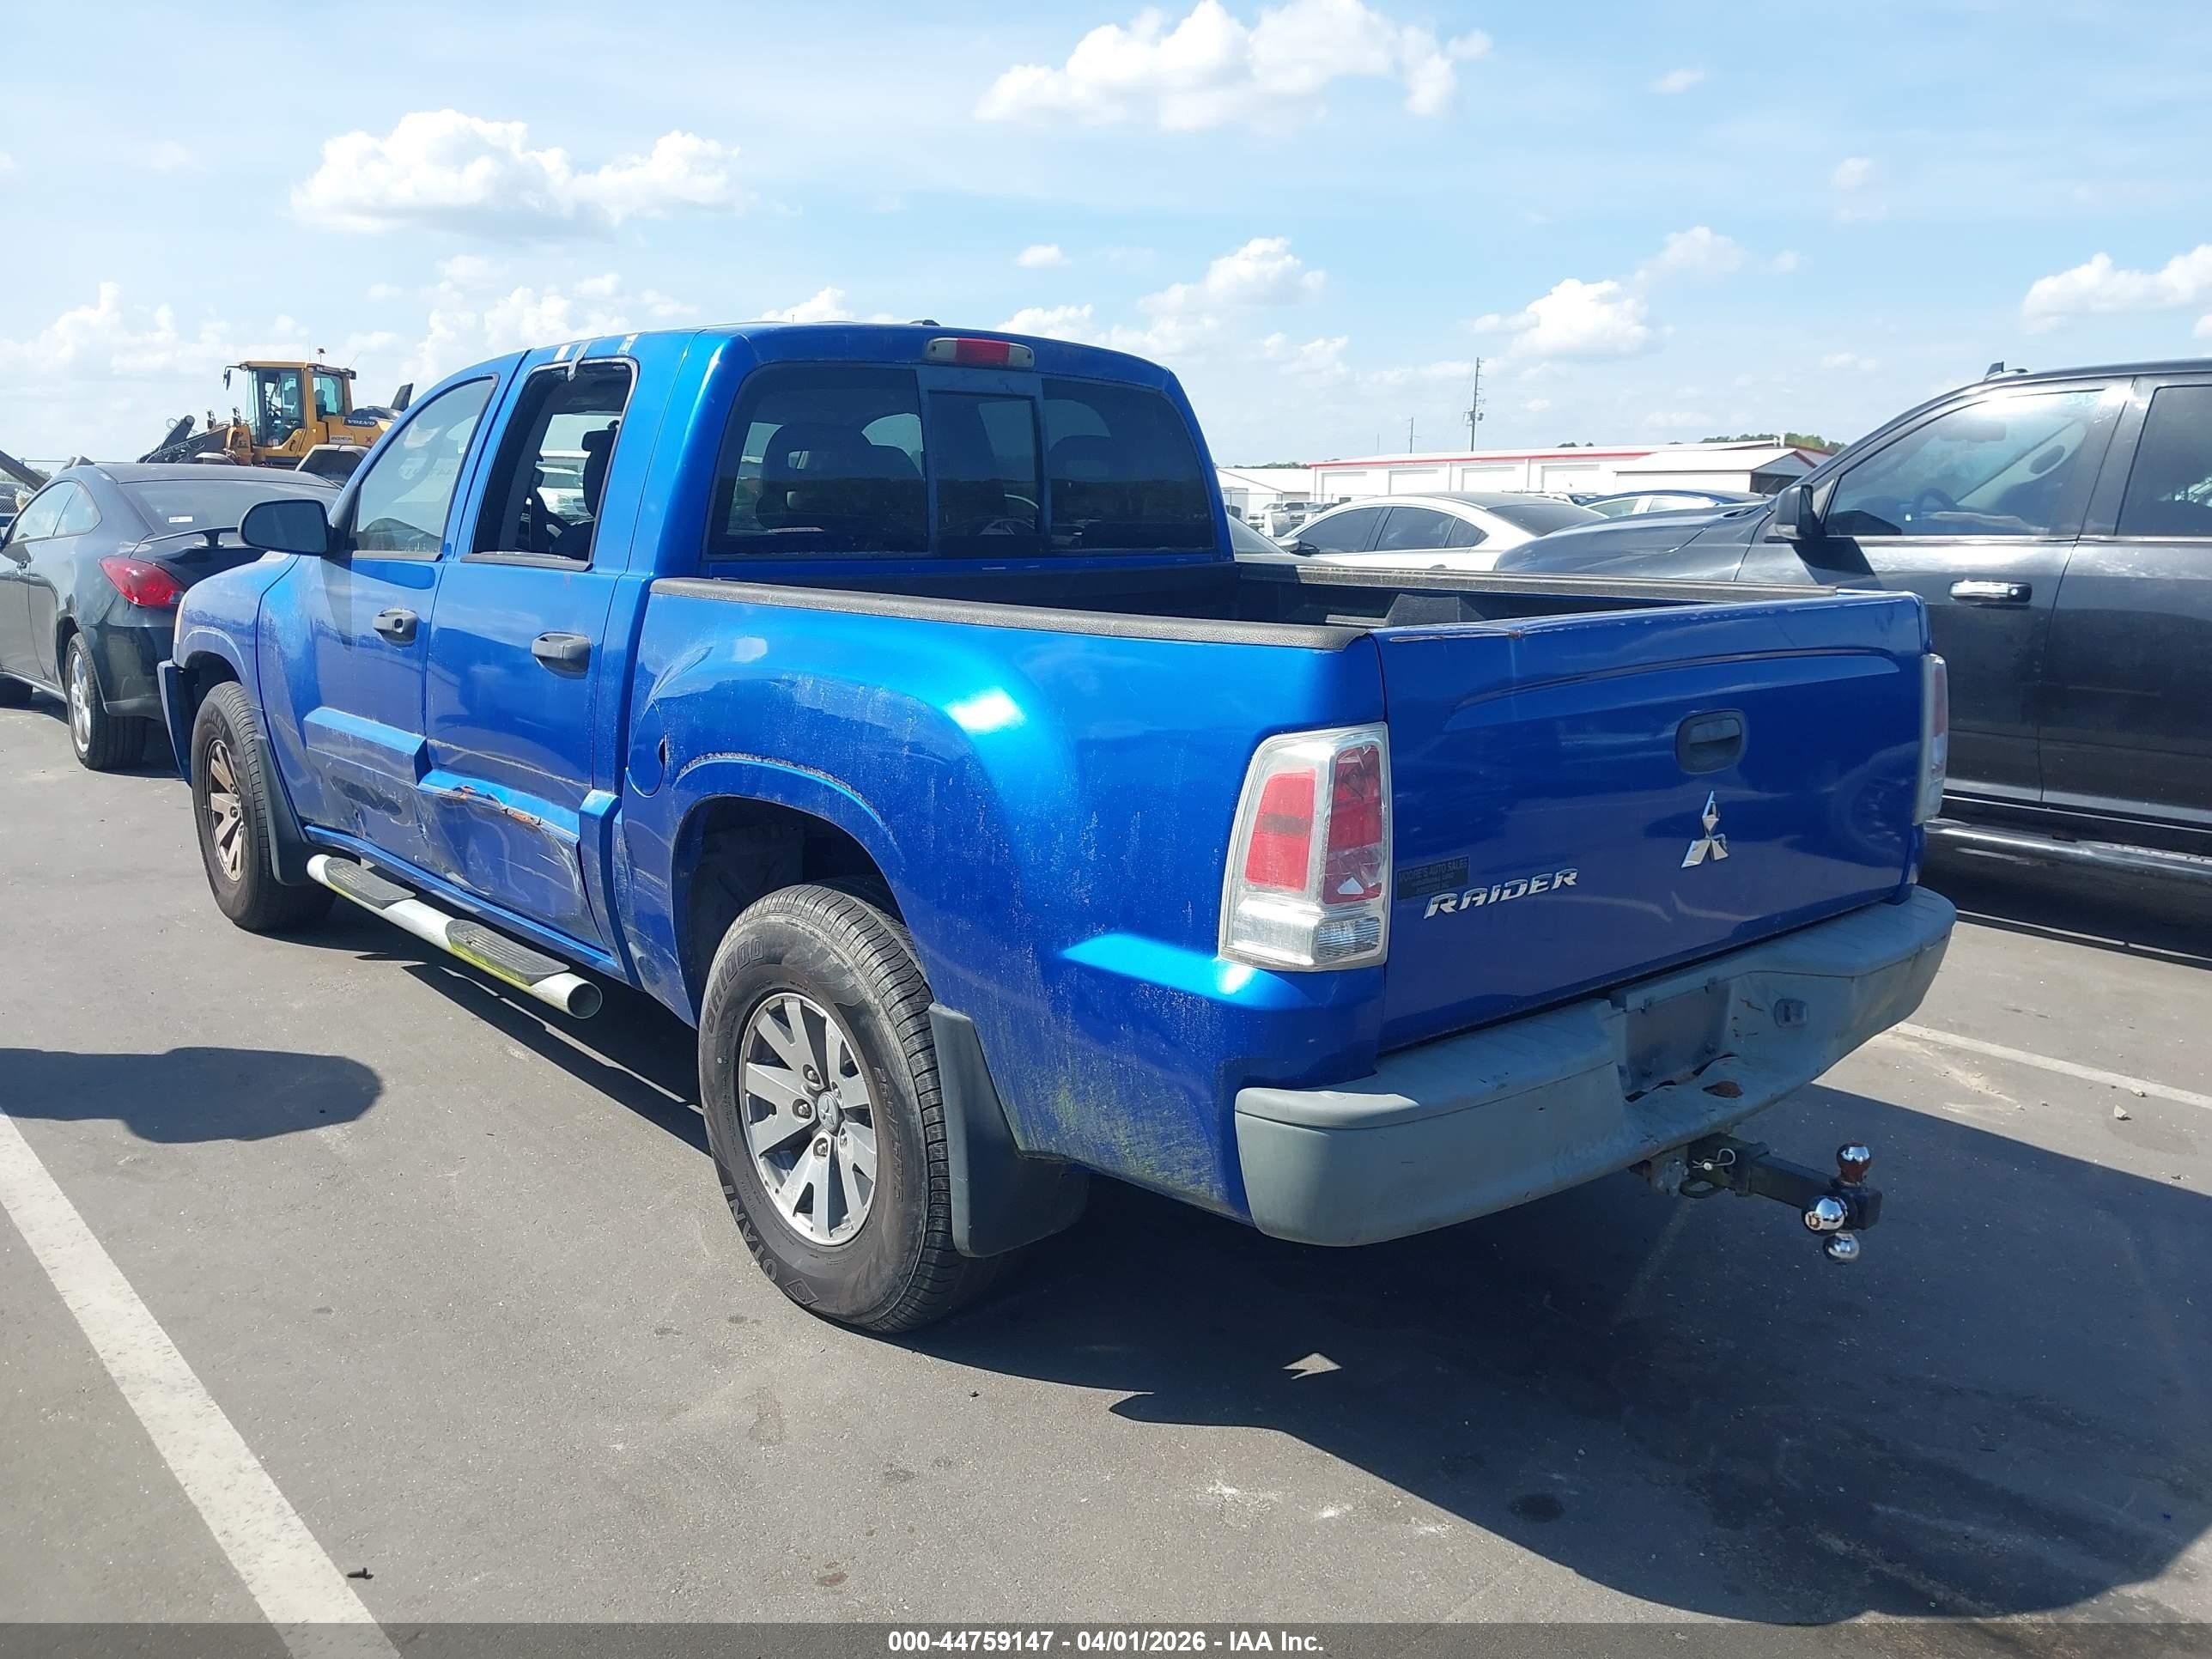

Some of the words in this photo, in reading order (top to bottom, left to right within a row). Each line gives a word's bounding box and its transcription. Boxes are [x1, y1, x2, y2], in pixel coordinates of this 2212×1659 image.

[1447, 858, 1468, 872] SALES
[1422, 867, 1579, 920] RAIDER
[723, 1185, 778, 1281] OTANI
